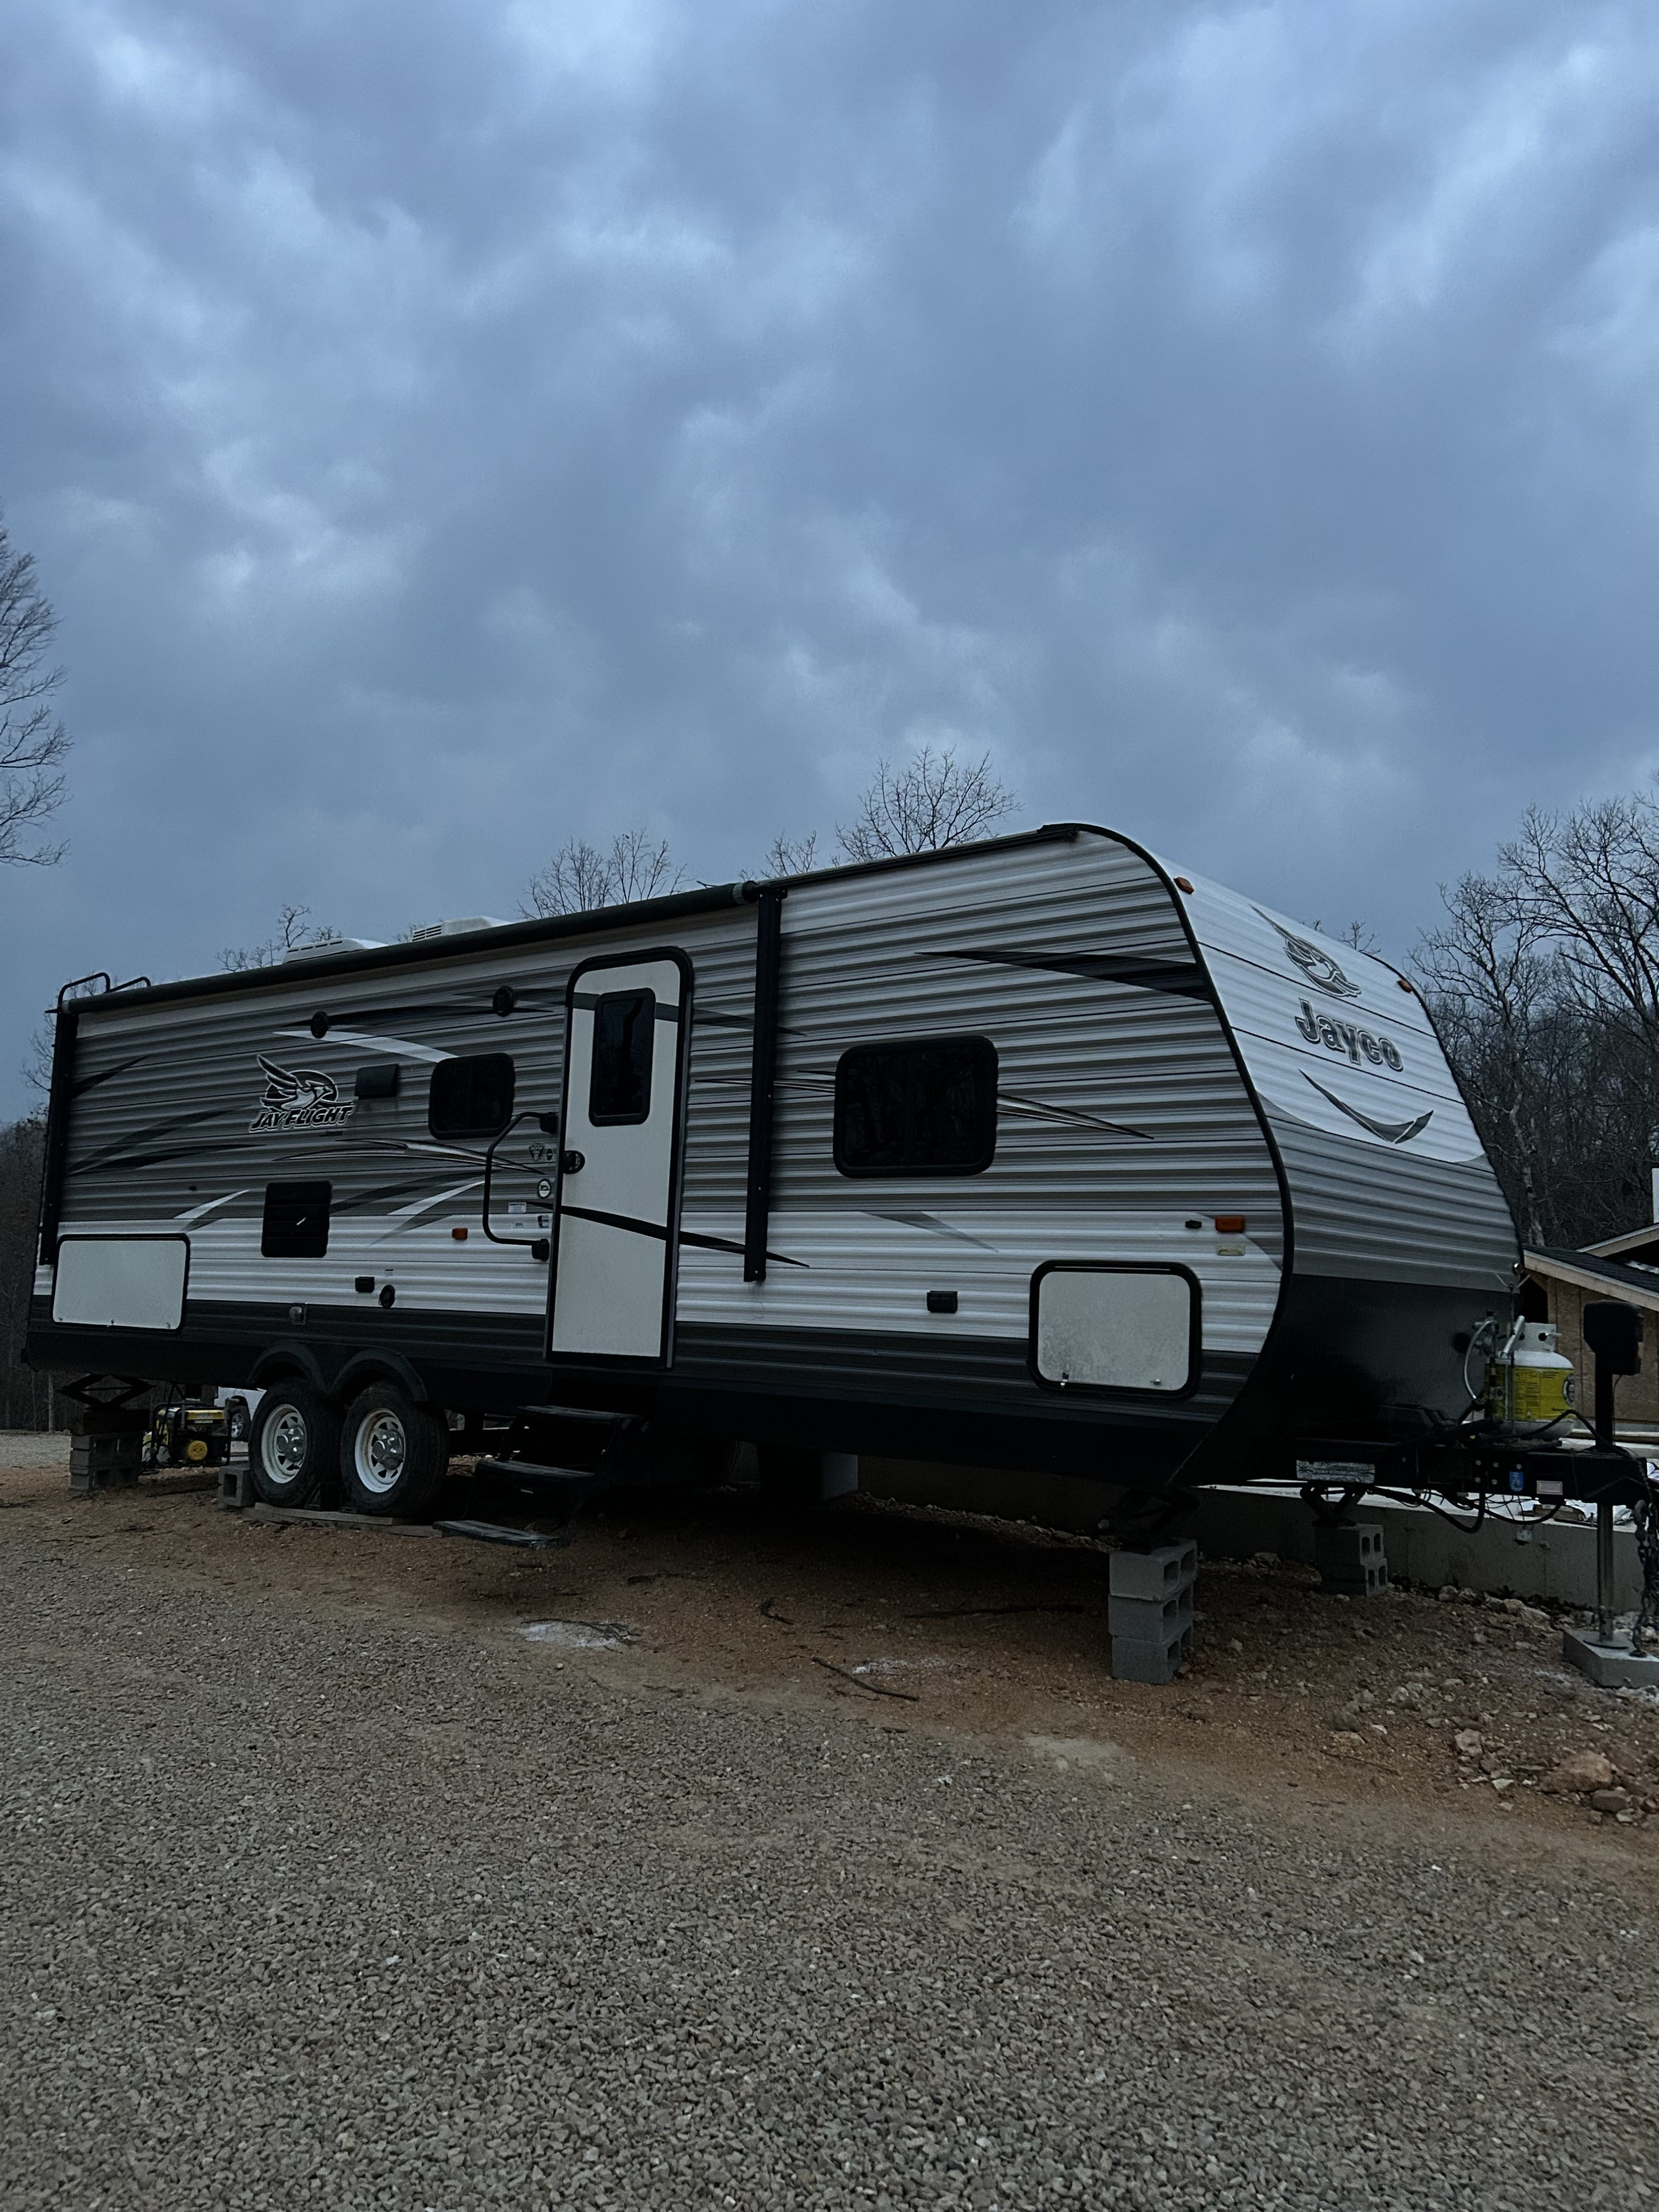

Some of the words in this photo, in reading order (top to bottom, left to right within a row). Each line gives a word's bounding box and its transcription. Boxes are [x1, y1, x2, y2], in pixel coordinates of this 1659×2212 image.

[1295, 998, 1404, 1071] Jayco
[250, 1111, 286, 1131] JAY
[284, 1105, 354, 1129] FLIGHT
